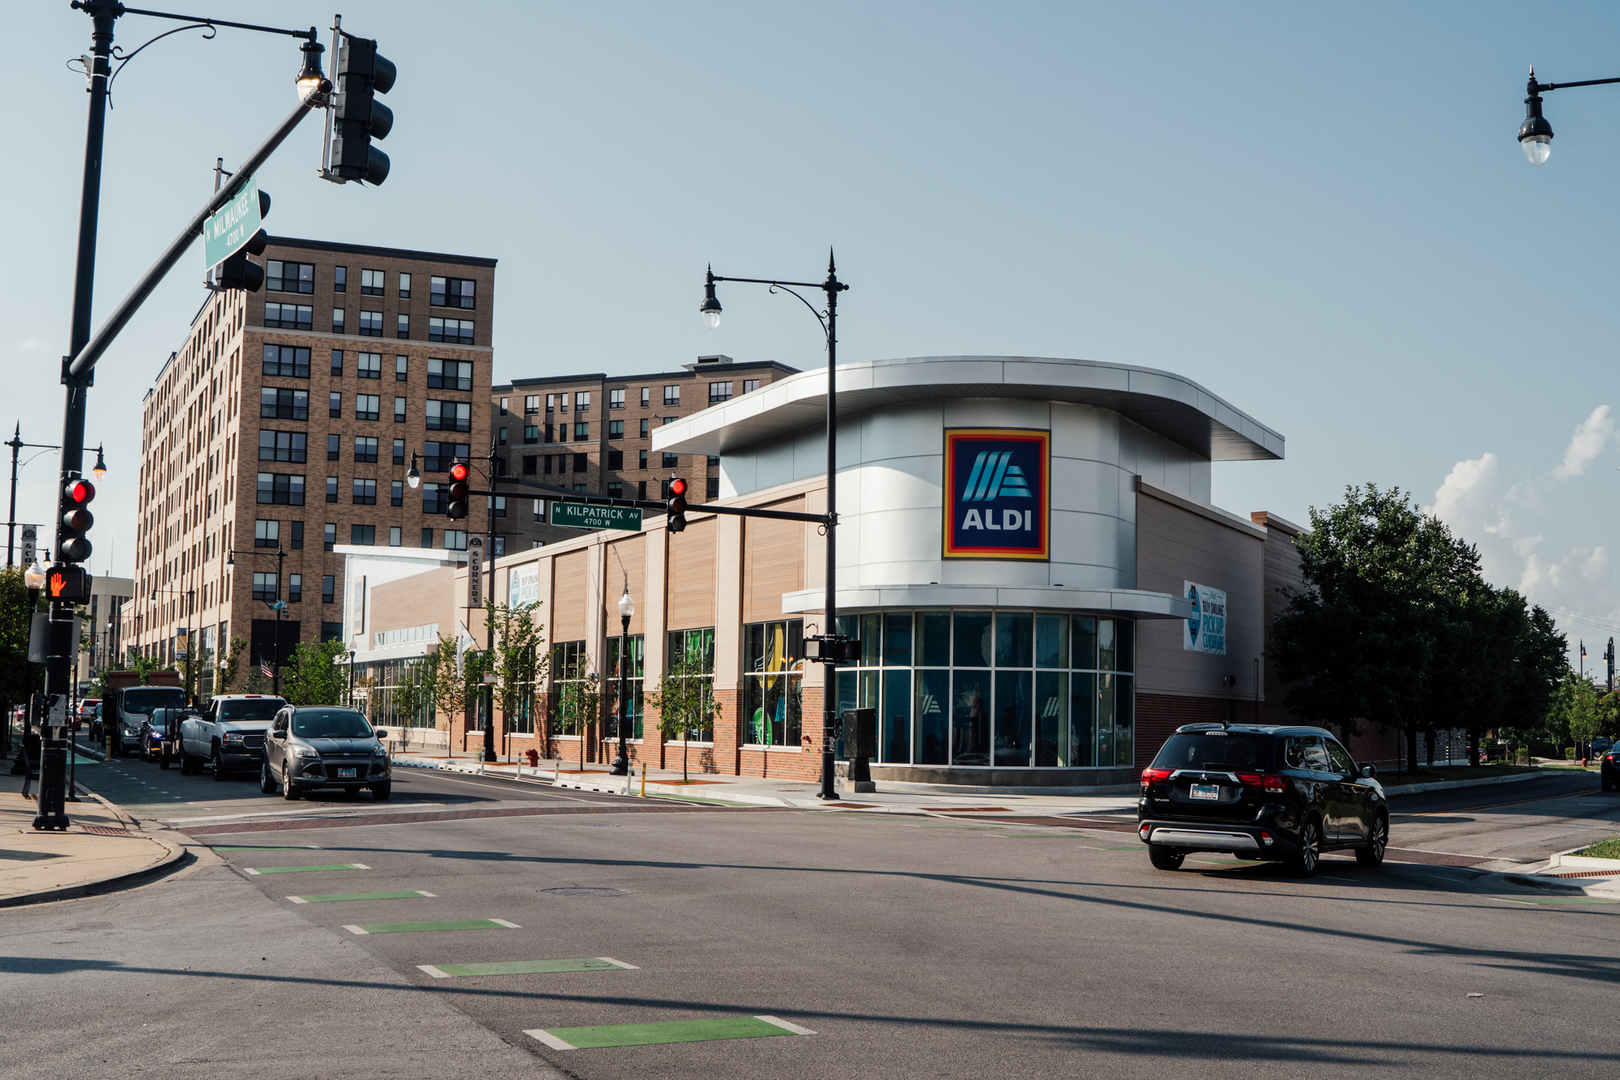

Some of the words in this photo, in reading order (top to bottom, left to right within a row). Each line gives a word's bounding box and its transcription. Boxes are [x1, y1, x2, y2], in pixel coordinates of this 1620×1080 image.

[206, 228, 211, 243] N
[213, 191, 249, 240] MILWAUKEE
[250, 185, 256, 204] AV
[226, 228, 240, 248] 4700
[555, 506, 561, 514] N
[566, 505, 624, 520] KILPATRICK
[628, 512, 639, 520] AV
[961, 508, 1032, 531] ALDI
[583, 517, 602, 526] 4700
[604, 519, 611, 527] W
[1211, 603, 1224, 616] ONLINE
[1203, 633, 1224, 649] CURBSIDE
